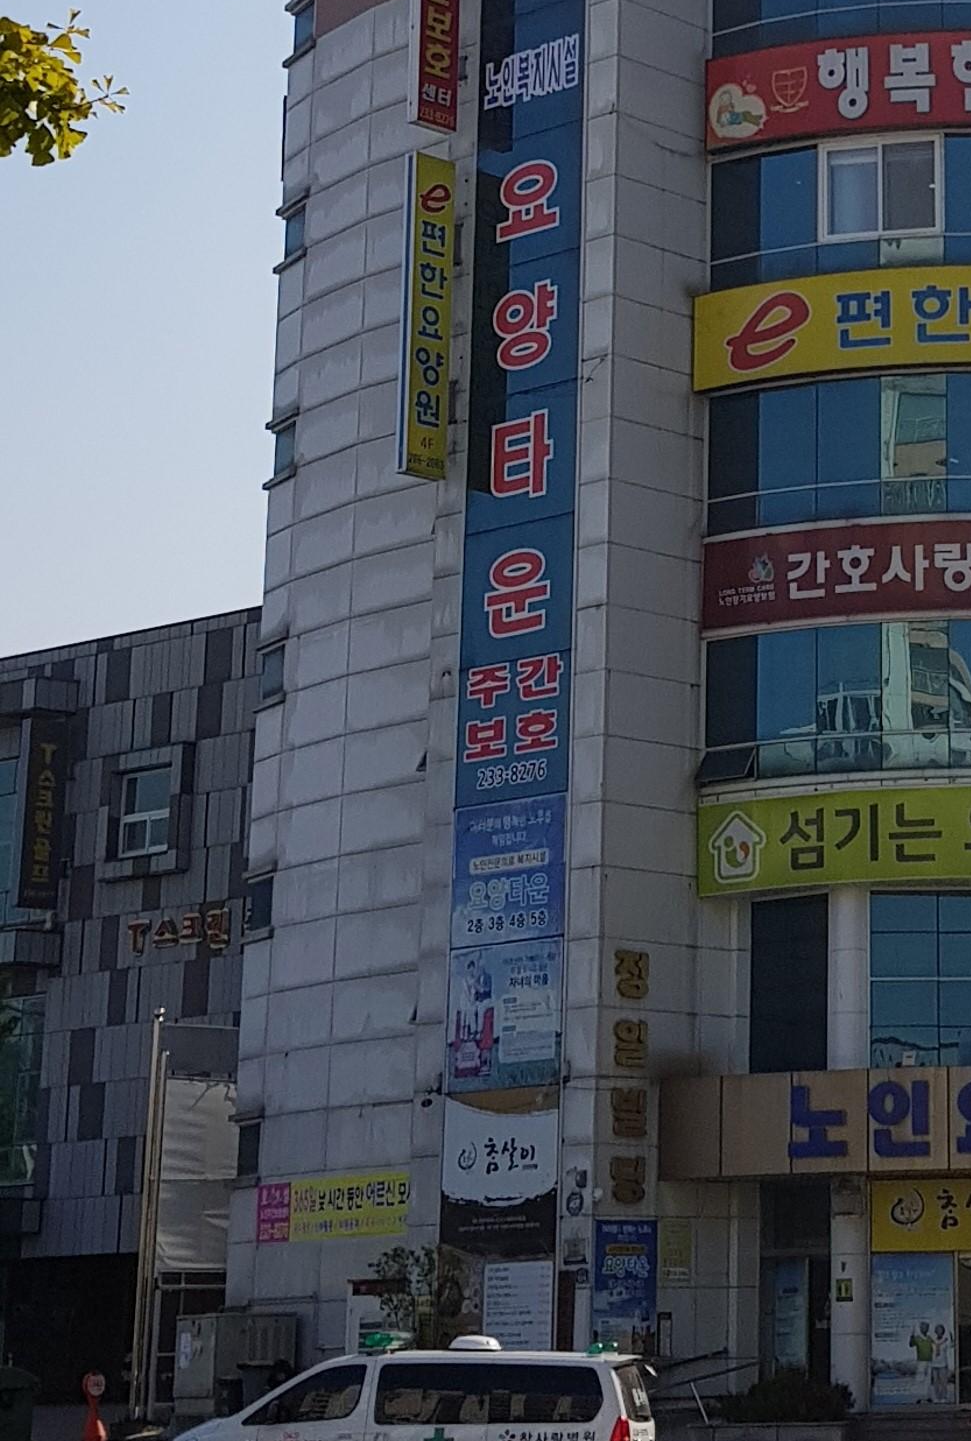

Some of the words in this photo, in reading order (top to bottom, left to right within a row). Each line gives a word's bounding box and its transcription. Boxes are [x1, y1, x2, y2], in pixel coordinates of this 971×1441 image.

[483, 33, 580, 110] 노인복지시설
[467, 653, 564, 709] 주간
[463, 709, 558, 763] 보호
[476, 760, 548, 791] 233-8276
[779, 801, 943, 871] 섬기는
[467, 872, 550, 911] 요양타운
